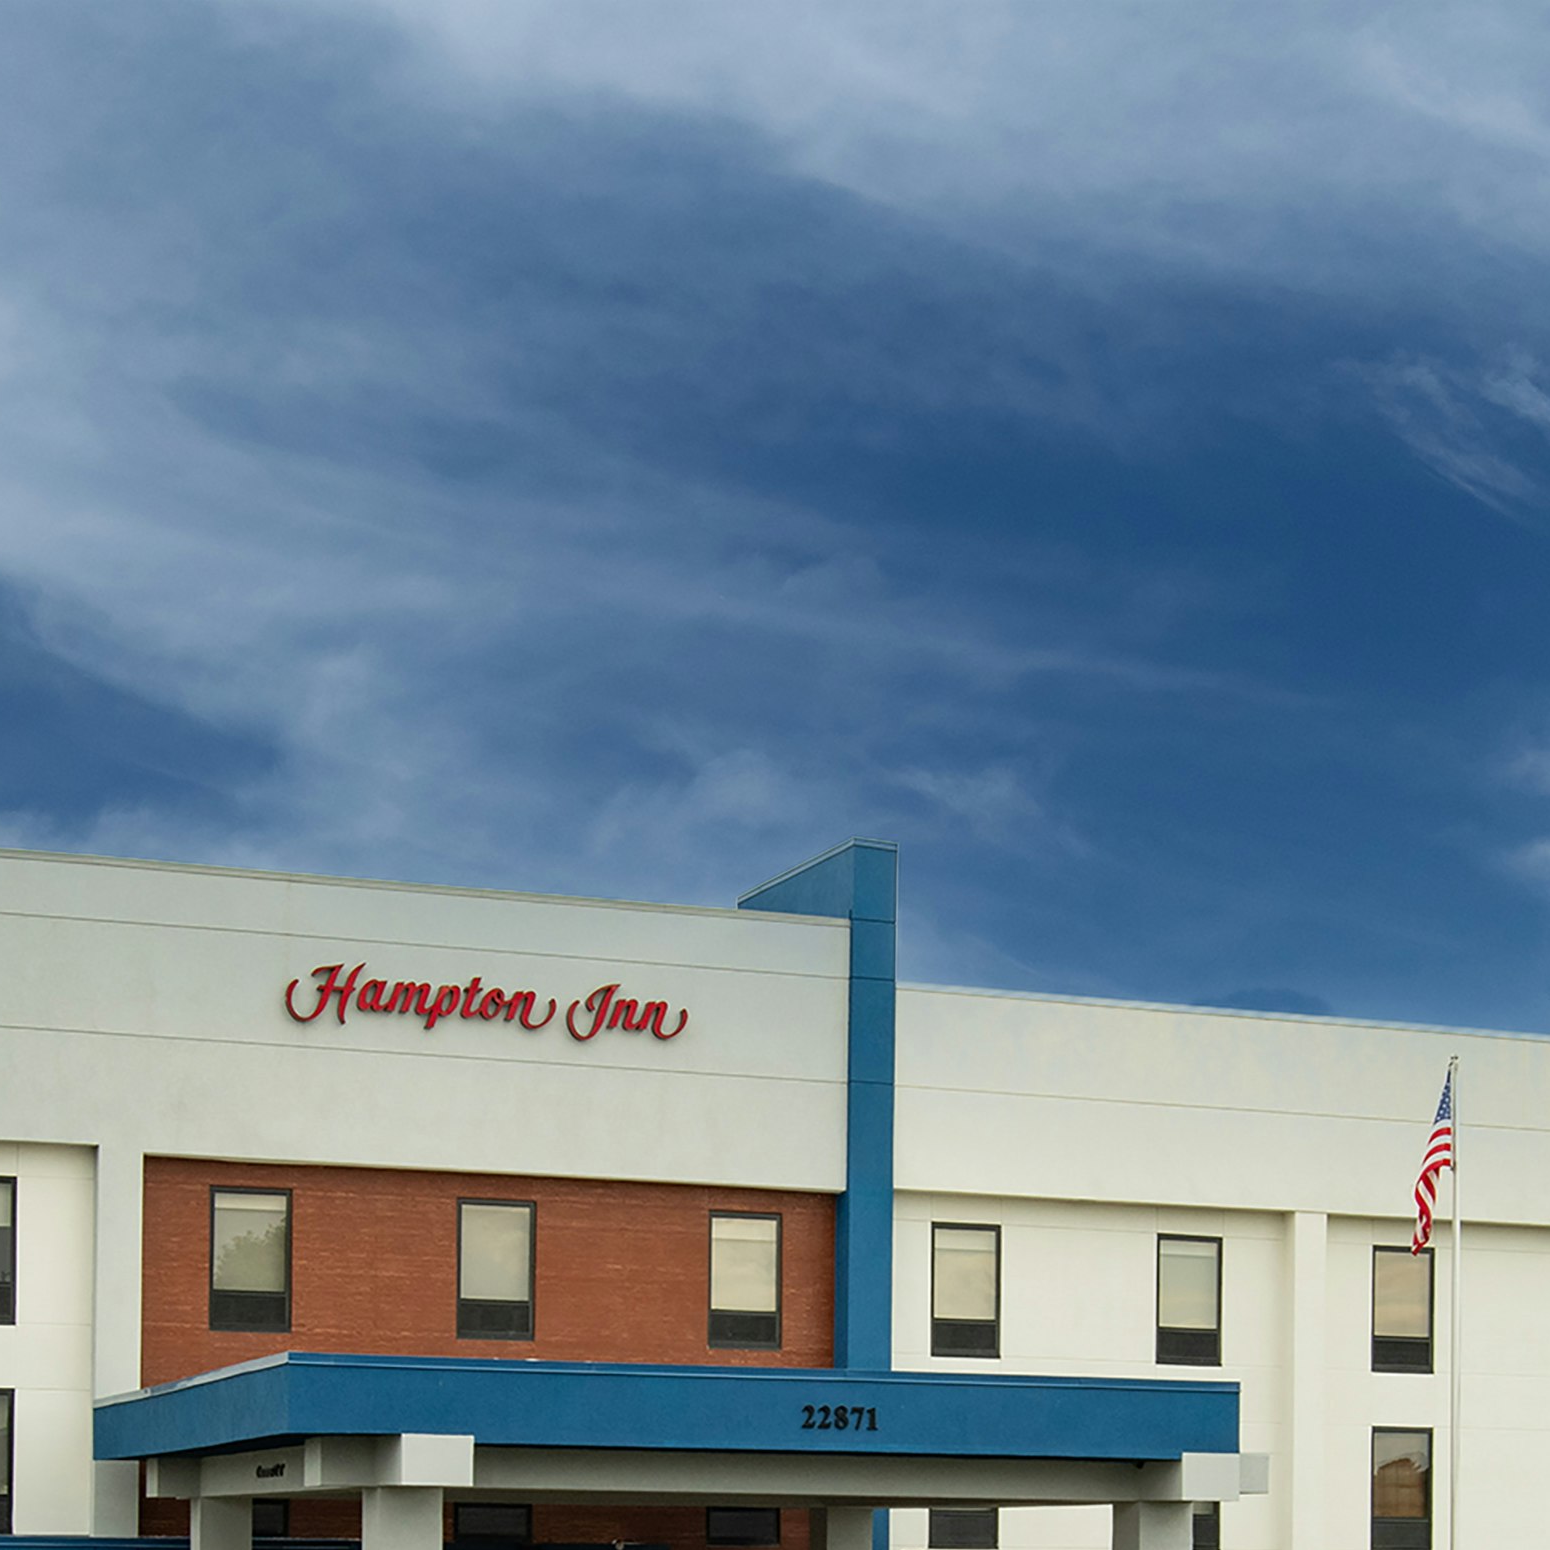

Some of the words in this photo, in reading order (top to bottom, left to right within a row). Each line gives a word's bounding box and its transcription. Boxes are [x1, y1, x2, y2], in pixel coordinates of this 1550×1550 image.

[285, 963, 557, 1030] Hampton
[567, 984, 689, 1041] Inn
[801, 1405, 878, 1431] 22871
